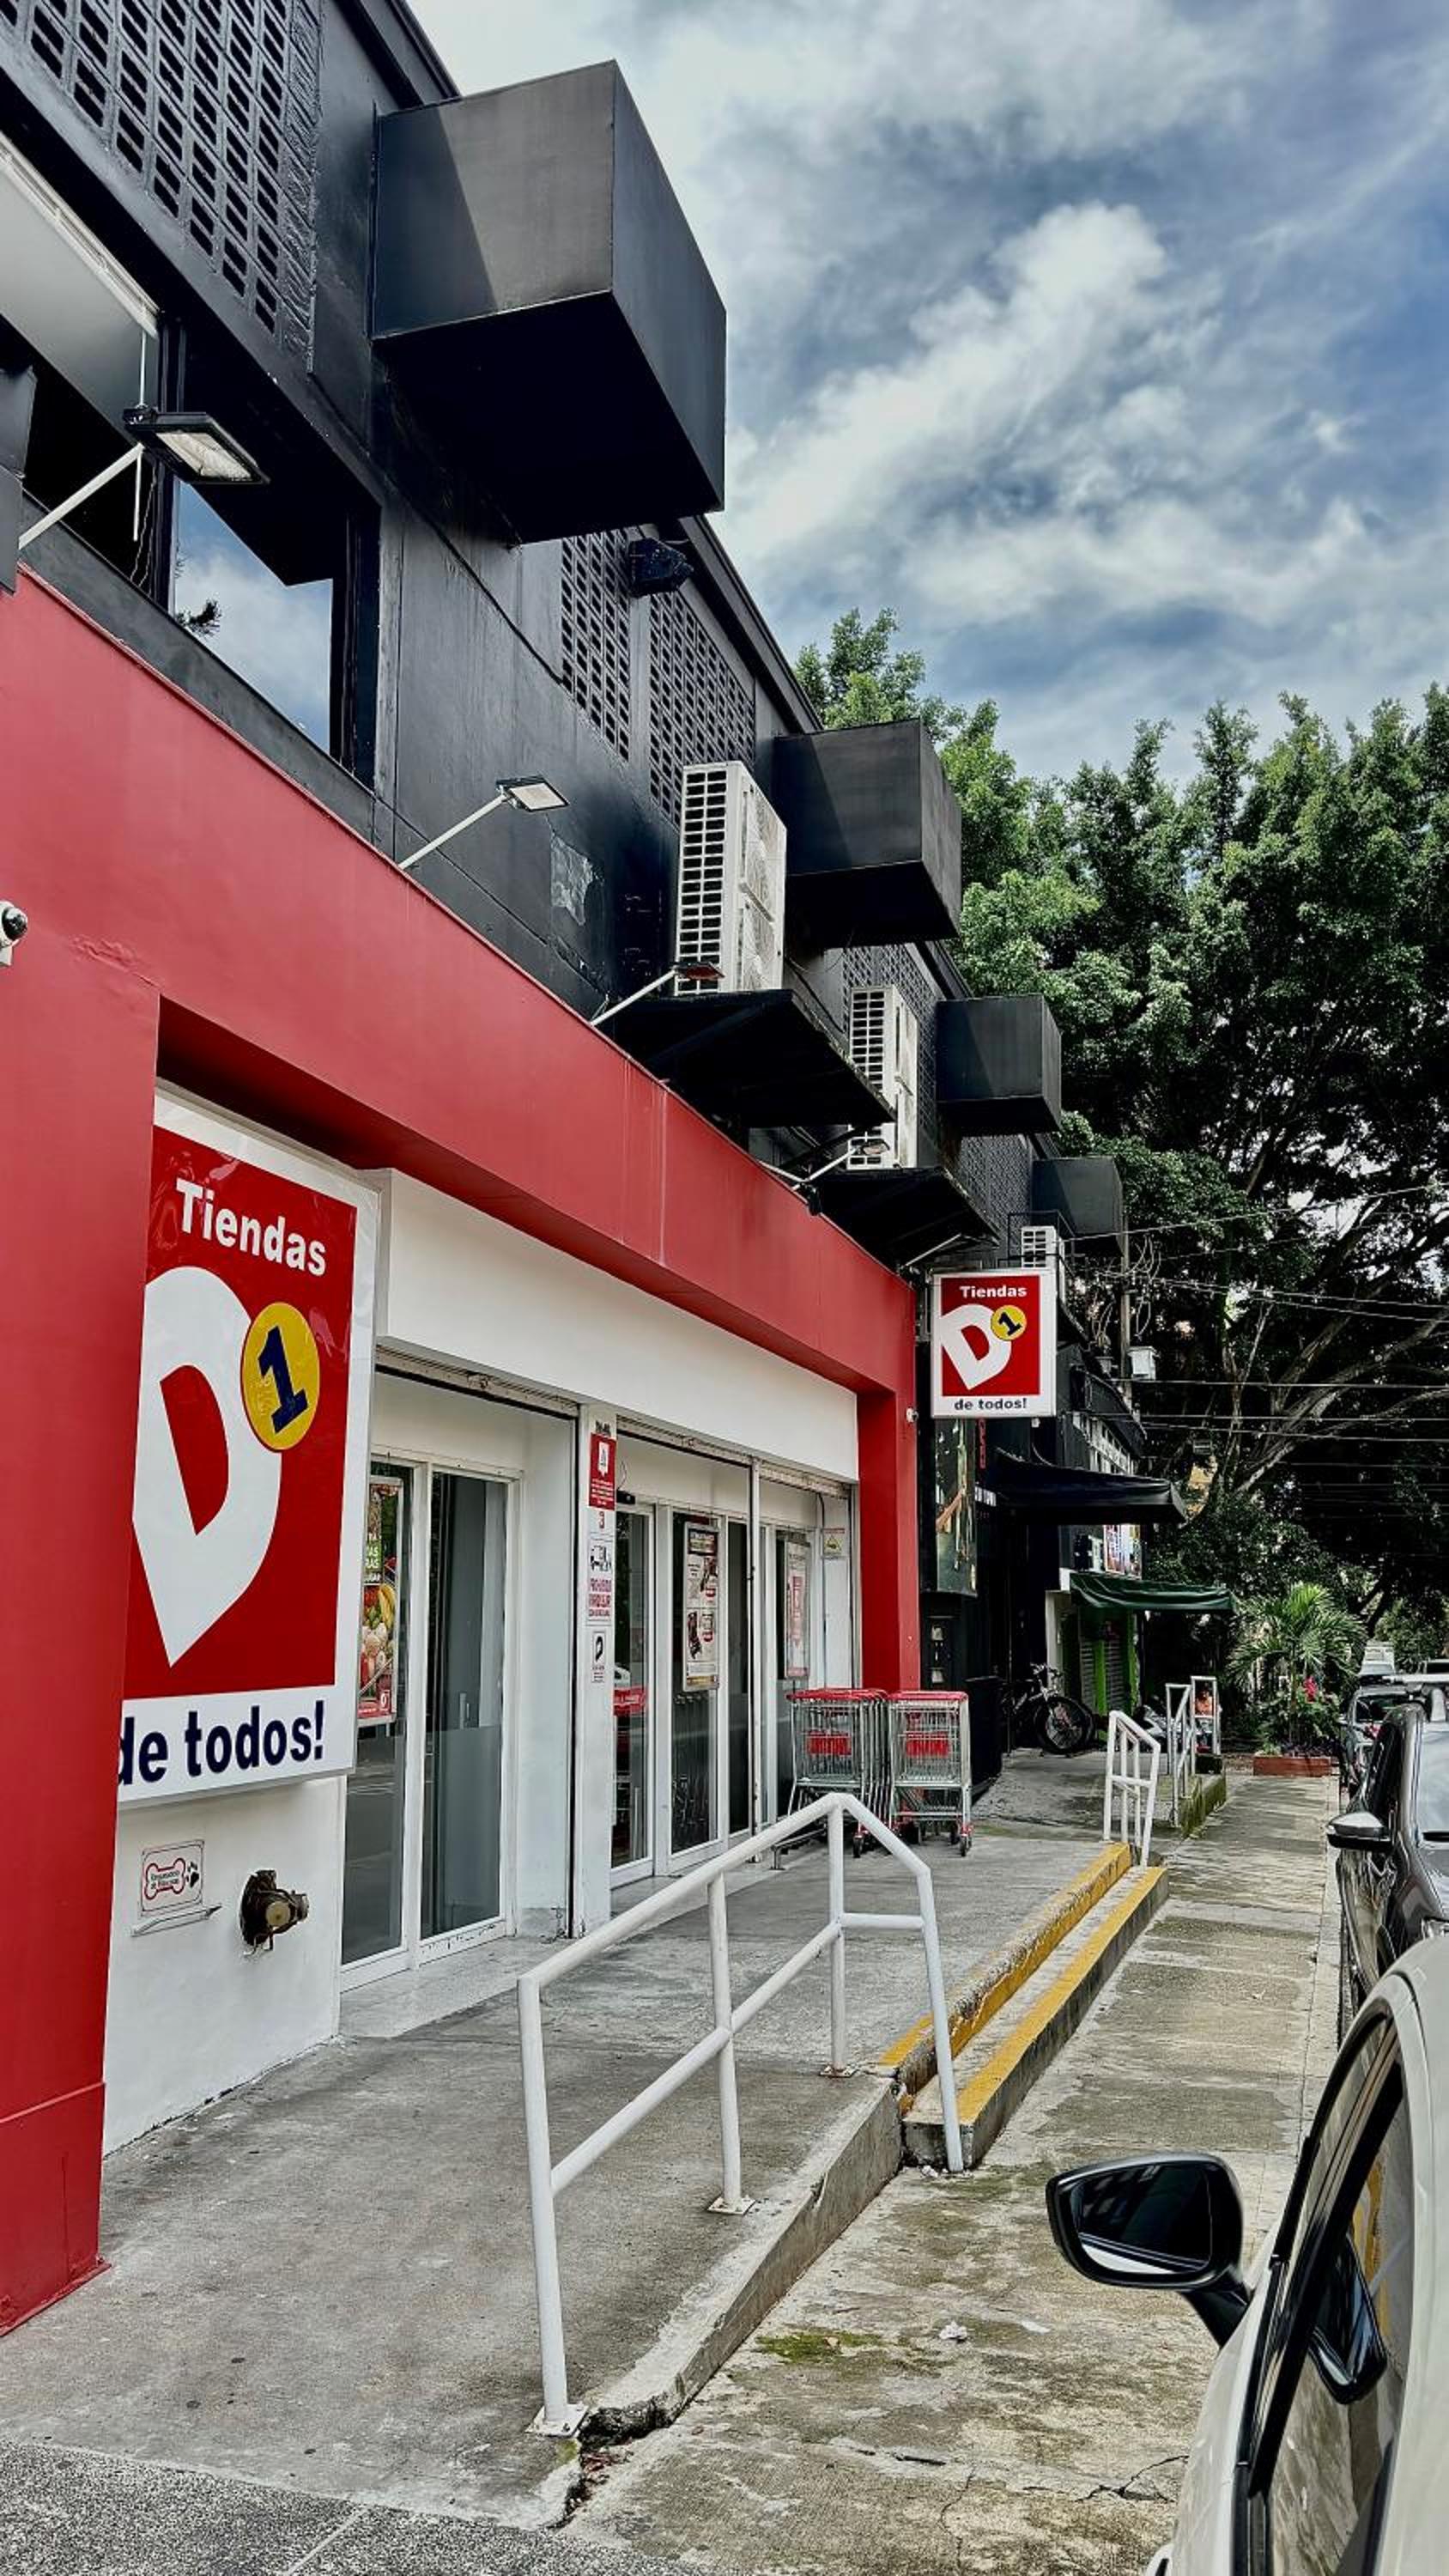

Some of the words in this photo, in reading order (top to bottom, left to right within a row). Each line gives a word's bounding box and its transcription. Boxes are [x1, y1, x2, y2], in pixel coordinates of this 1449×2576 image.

[175, 1177, 327, 1277] Tiendas
[959, 1285, 1028, 1299] Tiendas
[954, 1399, 973, 1411] de
[978, 1397, 1028, 1410] todos!
[185, 1699, 324, 1777] todos!
